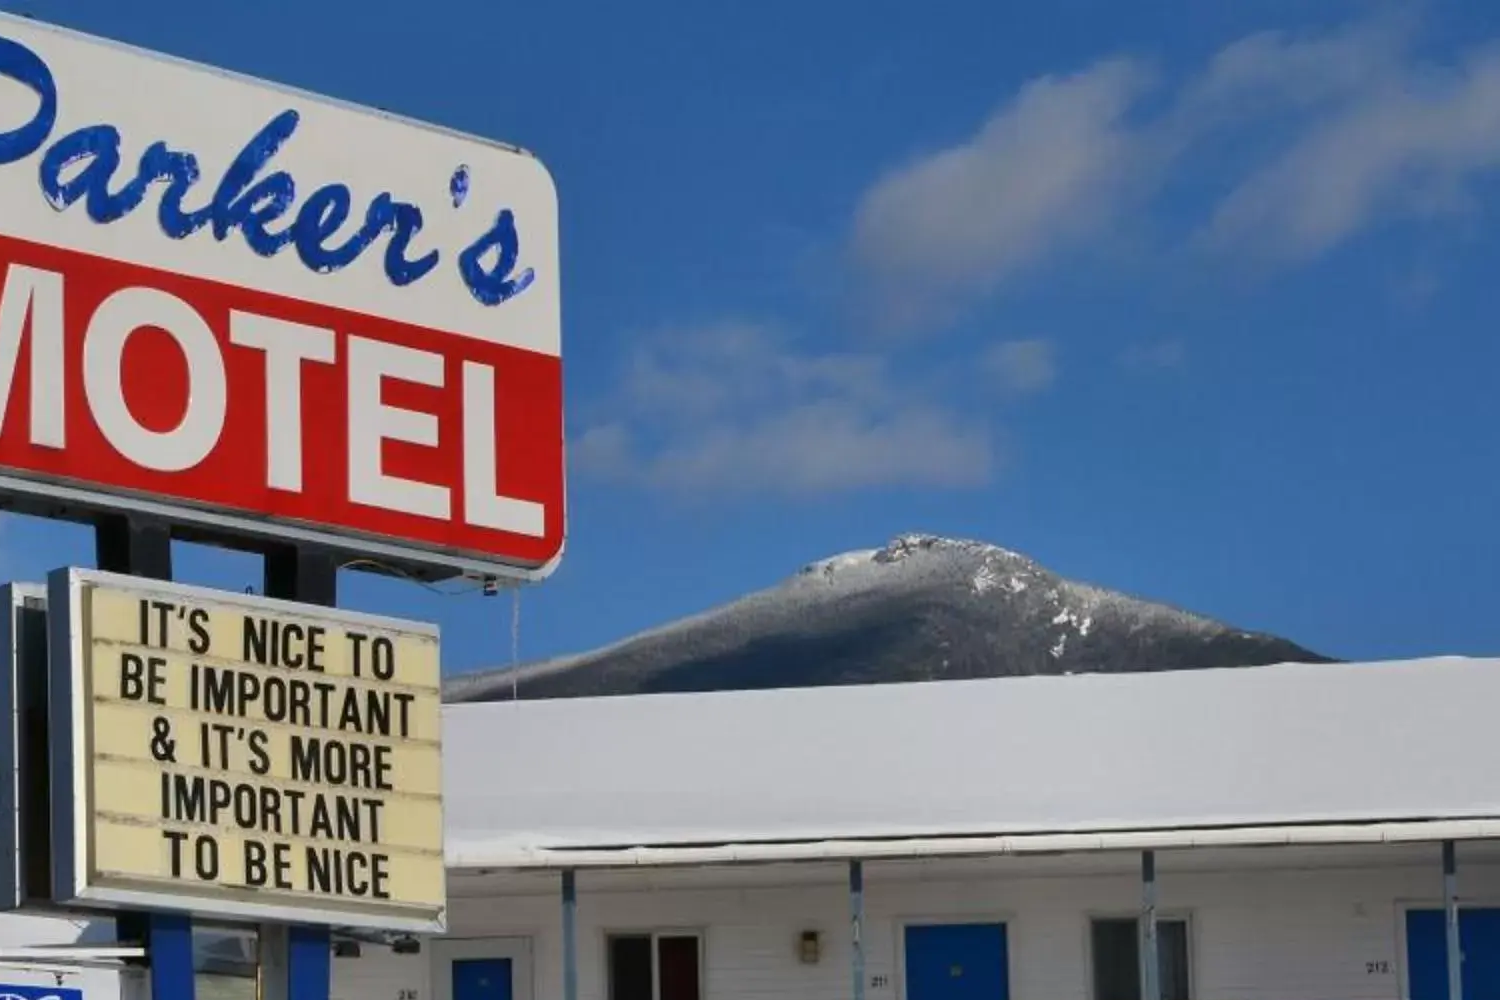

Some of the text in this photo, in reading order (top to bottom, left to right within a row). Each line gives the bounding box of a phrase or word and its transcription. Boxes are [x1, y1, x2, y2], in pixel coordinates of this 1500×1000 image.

[139, 599, 395, 680] IT'S NICE TO
[120, 653, 415, 737] BE IMPORTANT
[150, 715, 393, 791] & IT'S MORE
[161, 771, 384, 843] IMPORTANT
[163, 831, 389, 899] TO BE NICE
